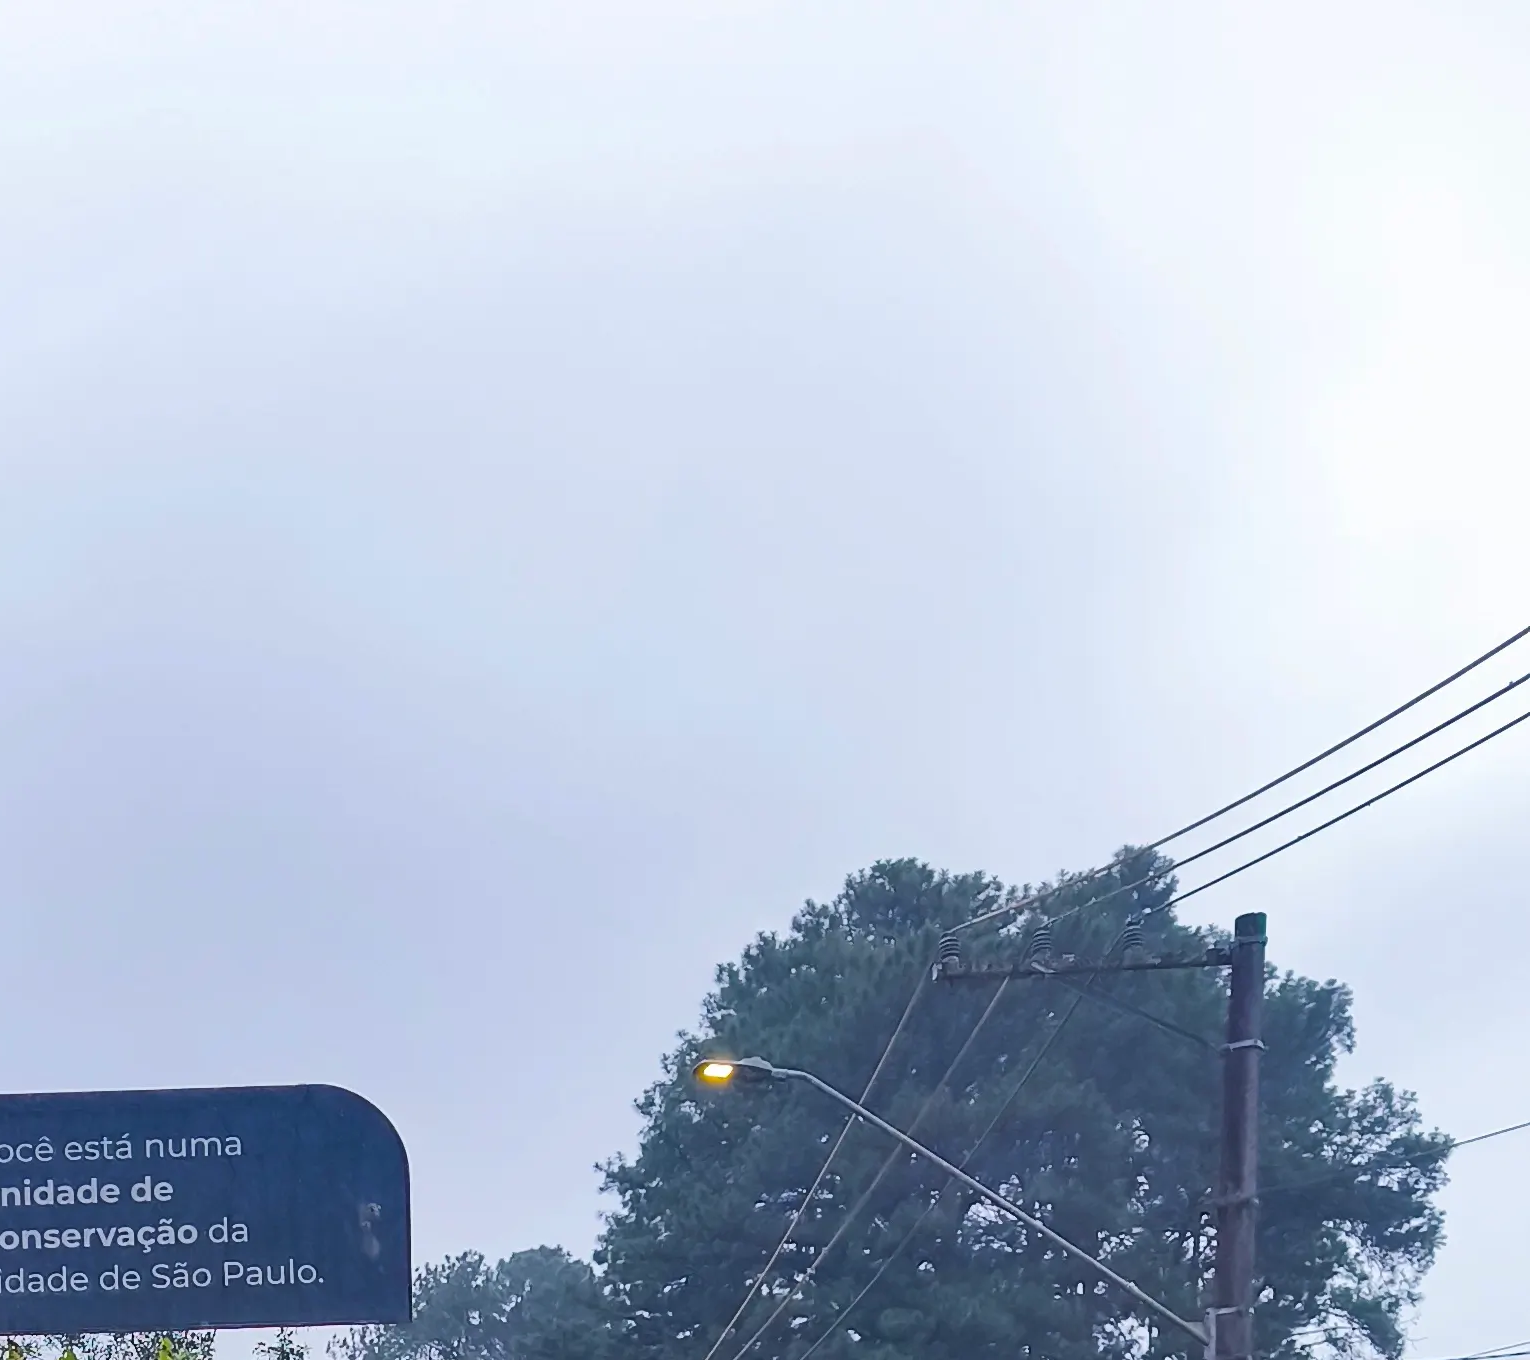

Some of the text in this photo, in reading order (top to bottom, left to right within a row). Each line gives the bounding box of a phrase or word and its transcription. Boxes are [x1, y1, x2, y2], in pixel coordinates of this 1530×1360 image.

[63, 1133, 133, 1162] está
[144, 1132, 243, 1159] numa
[130, 1176, 174, 1203] de
[208, 1216, 249, 1244] da
[99, 1263, 141, 1291] de
[151, 1261, 213, 1290] São
[222, 1258, 325, 1287] Paulo.
